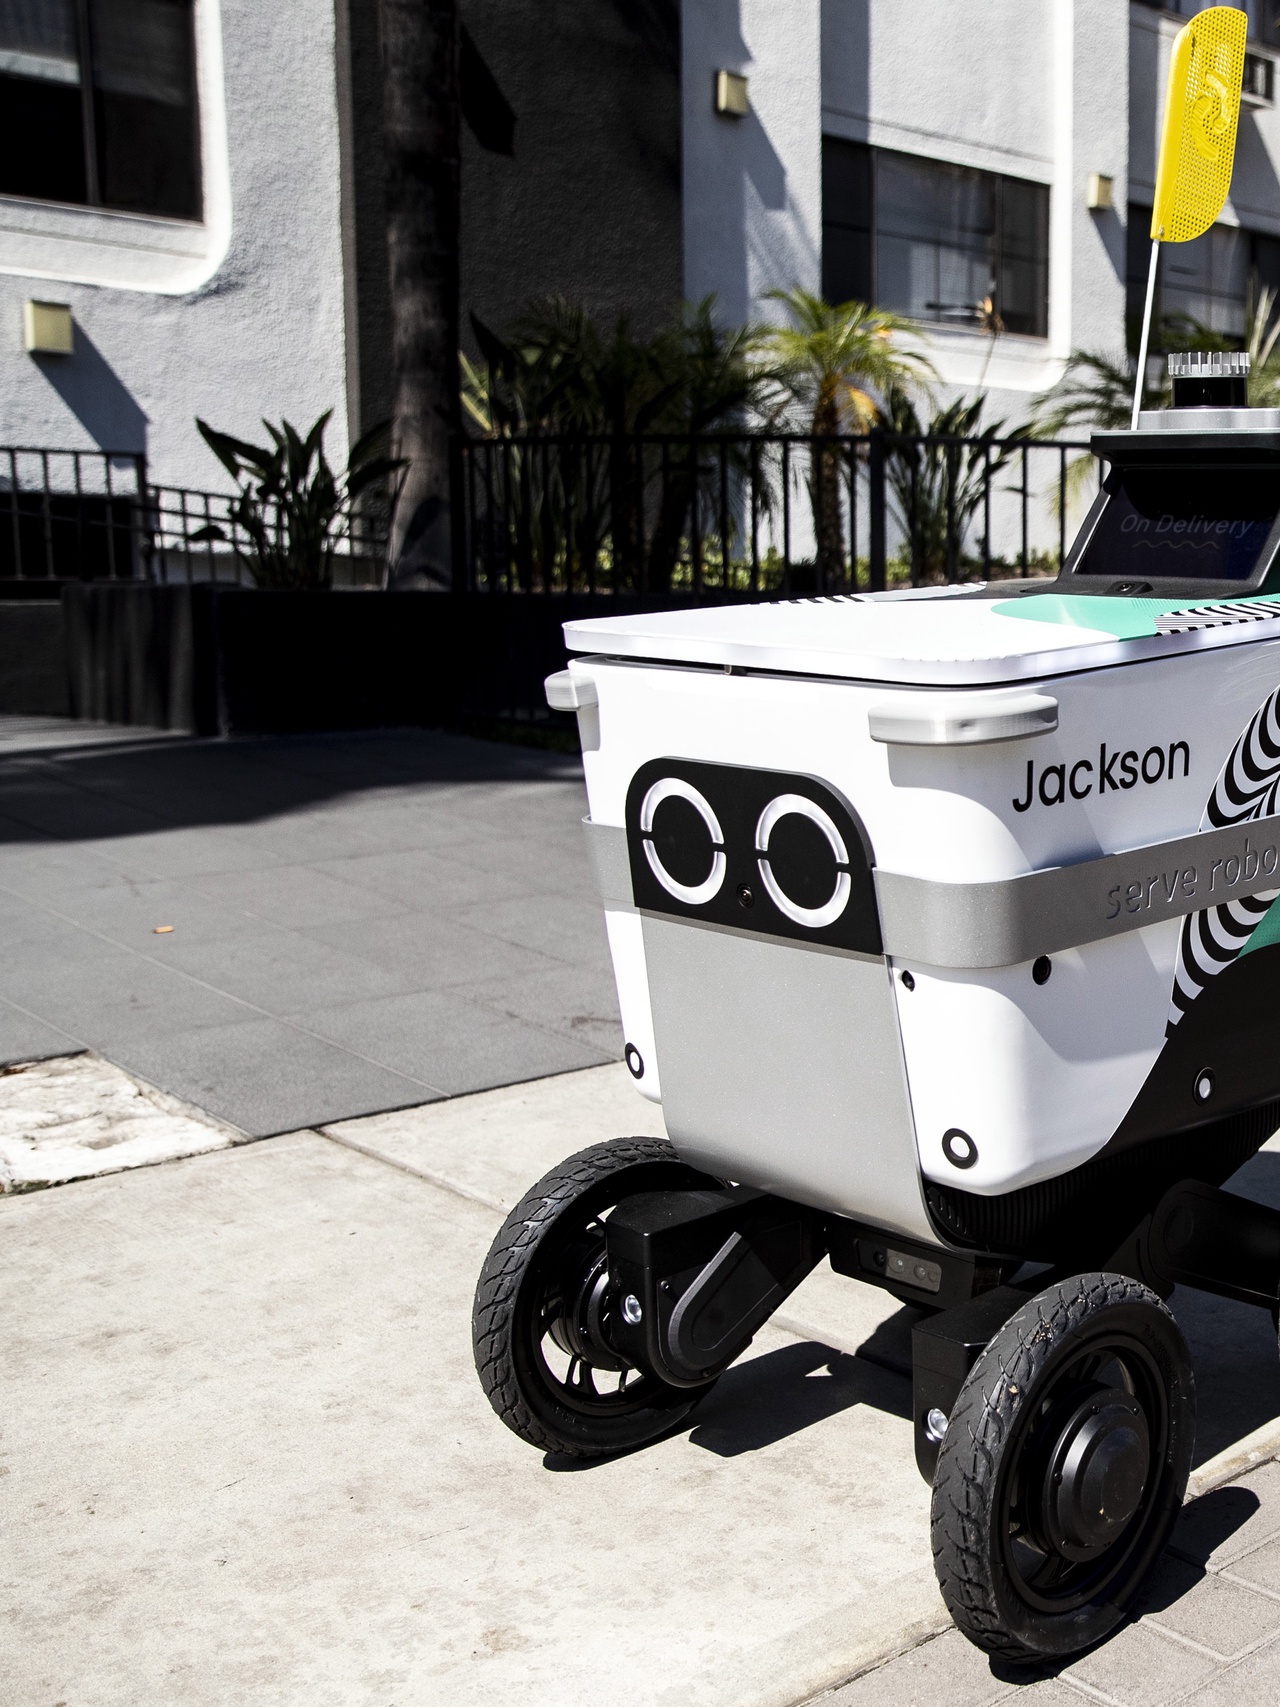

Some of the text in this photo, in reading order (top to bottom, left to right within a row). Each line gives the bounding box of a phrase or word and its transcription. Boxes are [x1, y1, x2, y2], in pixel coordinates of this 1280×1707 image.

[1121, 514, 1255, 539] On Delivery
[1012, 740, 1190, 813] Jackson
[1105, 863, 1199, 920] serve
